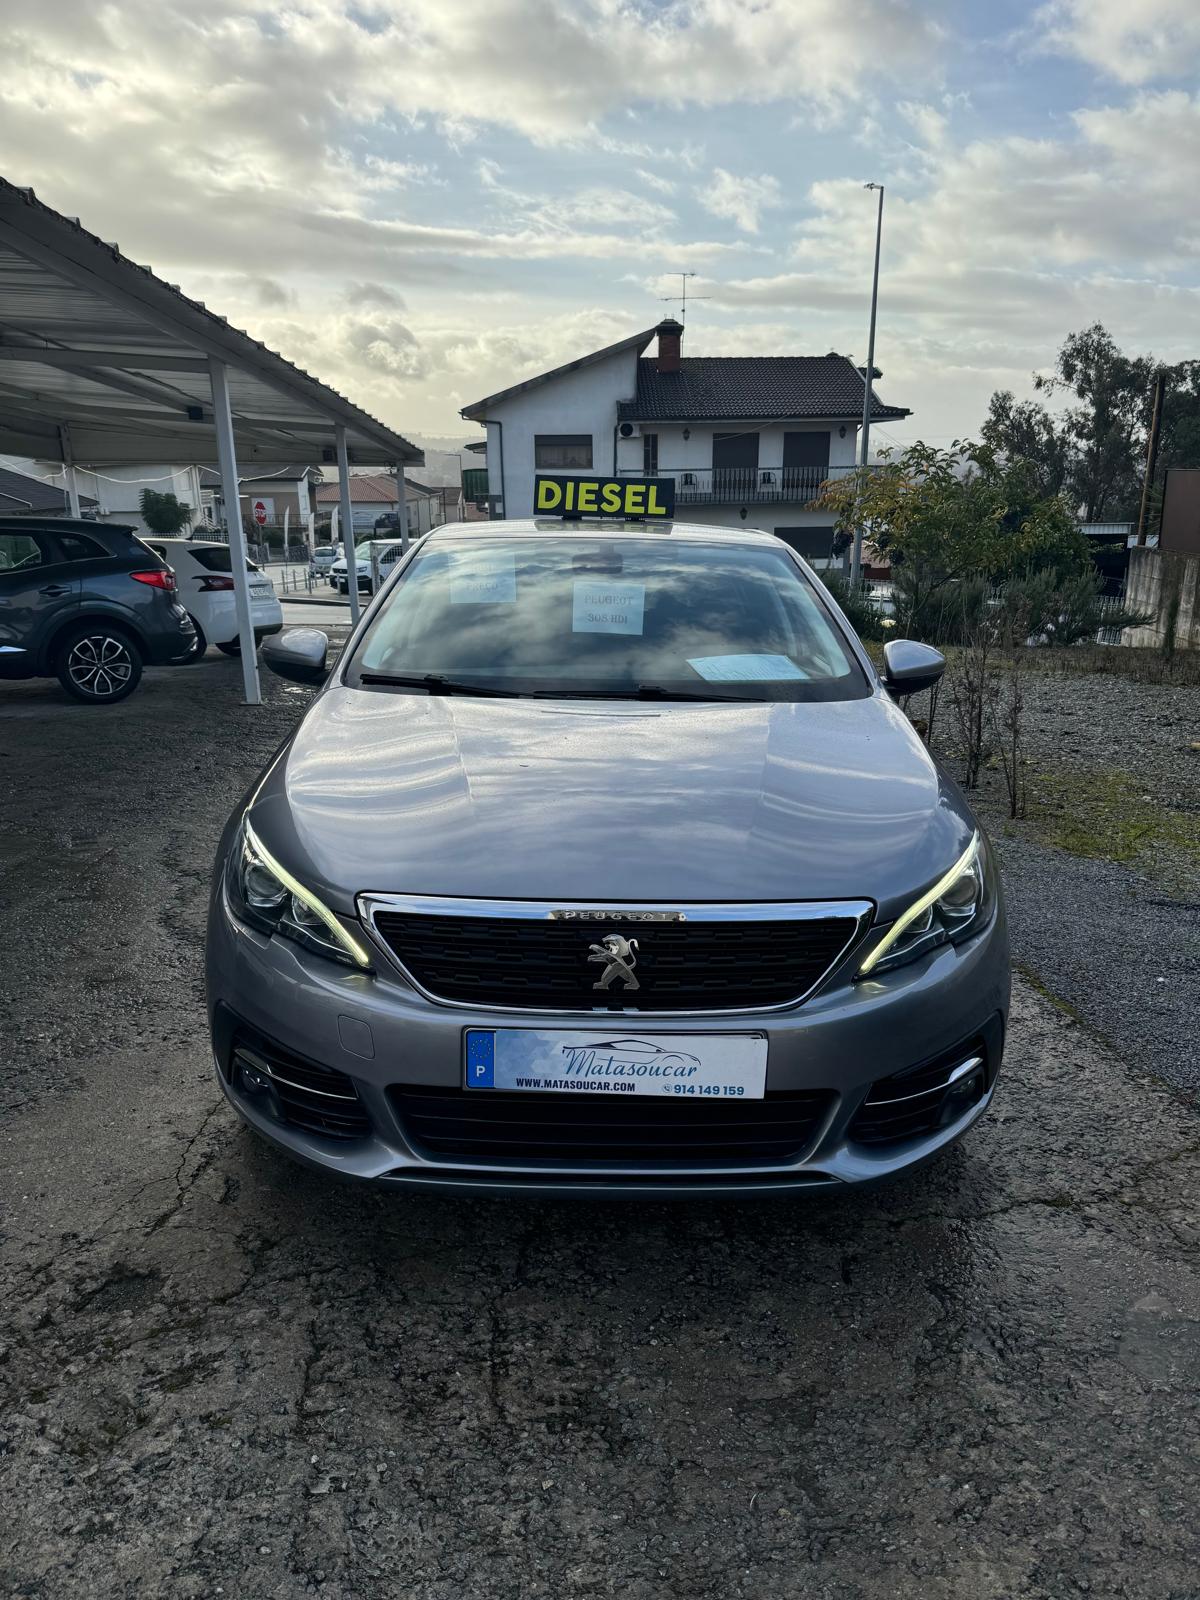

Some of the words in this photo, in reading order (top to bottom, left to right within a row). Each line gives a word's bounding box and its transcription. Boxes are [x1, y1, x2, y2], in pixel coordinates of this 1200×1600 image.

[537, 480, 666, 515] DIESEL
[584, 594, 634, 605] PEUGEOT
[565, 909, 670, 920] PEUGEOT
[562, 1049, 697, 1078] Matasoucar
[476, 1065, 486, 1077] P
[516, 1078, 636, 1092] WWW.MATASOUCAR.COM
[674, 1084, 695, 1095] 914
[699, 1085, 720, 1095] 149
[723, 1086, 745, 1096] 159
